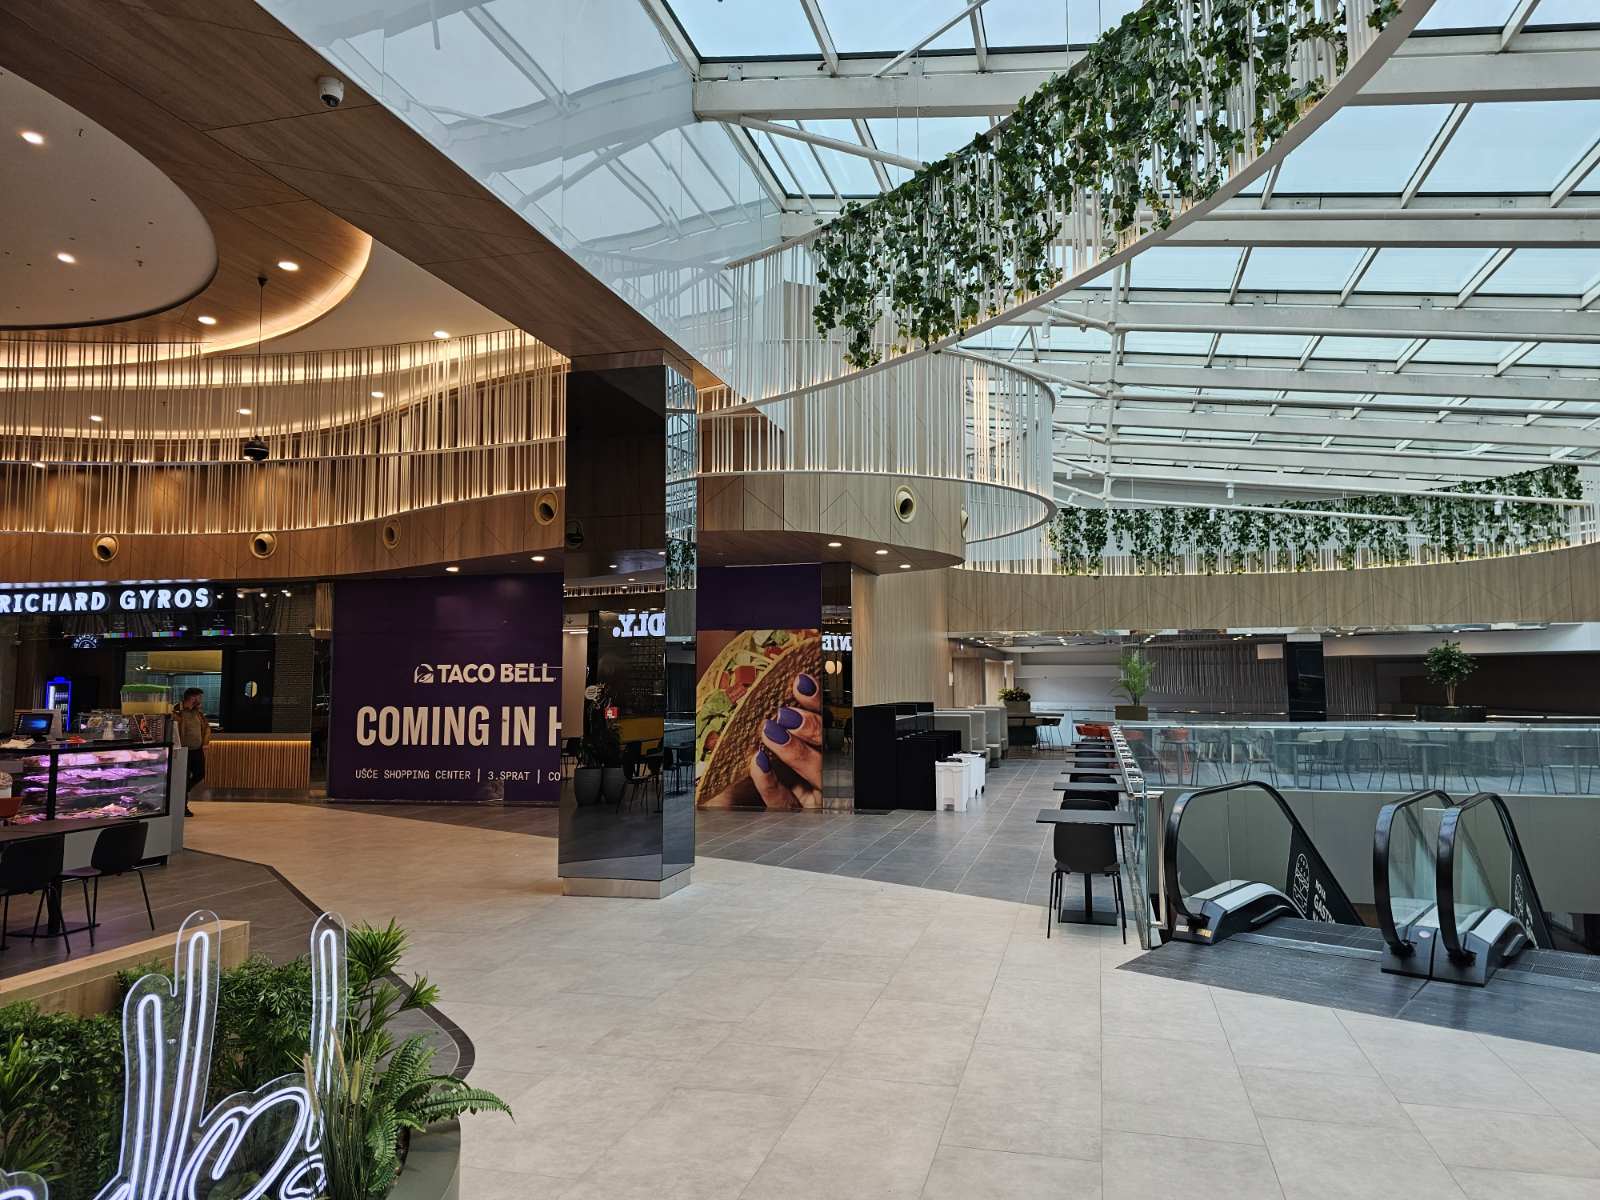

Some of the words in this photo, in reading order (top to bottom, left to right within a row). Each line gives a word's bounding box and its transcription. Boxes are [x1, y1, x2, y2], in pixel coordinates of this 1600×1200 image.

[0, 592, 106, 613] RICHARD
[119, 588, 209, 610] GYROS
[437, 663, 496, 684] TACO
[500, 663, 555, 684] BELL
[356, 705, 490, 747] COMING
[501, 706, 536, 747] IN
[384, 769, 430, 780] SHOPPING
[435, 770, 471, 781] CENTER
[548, 771, 561, 782] CO
